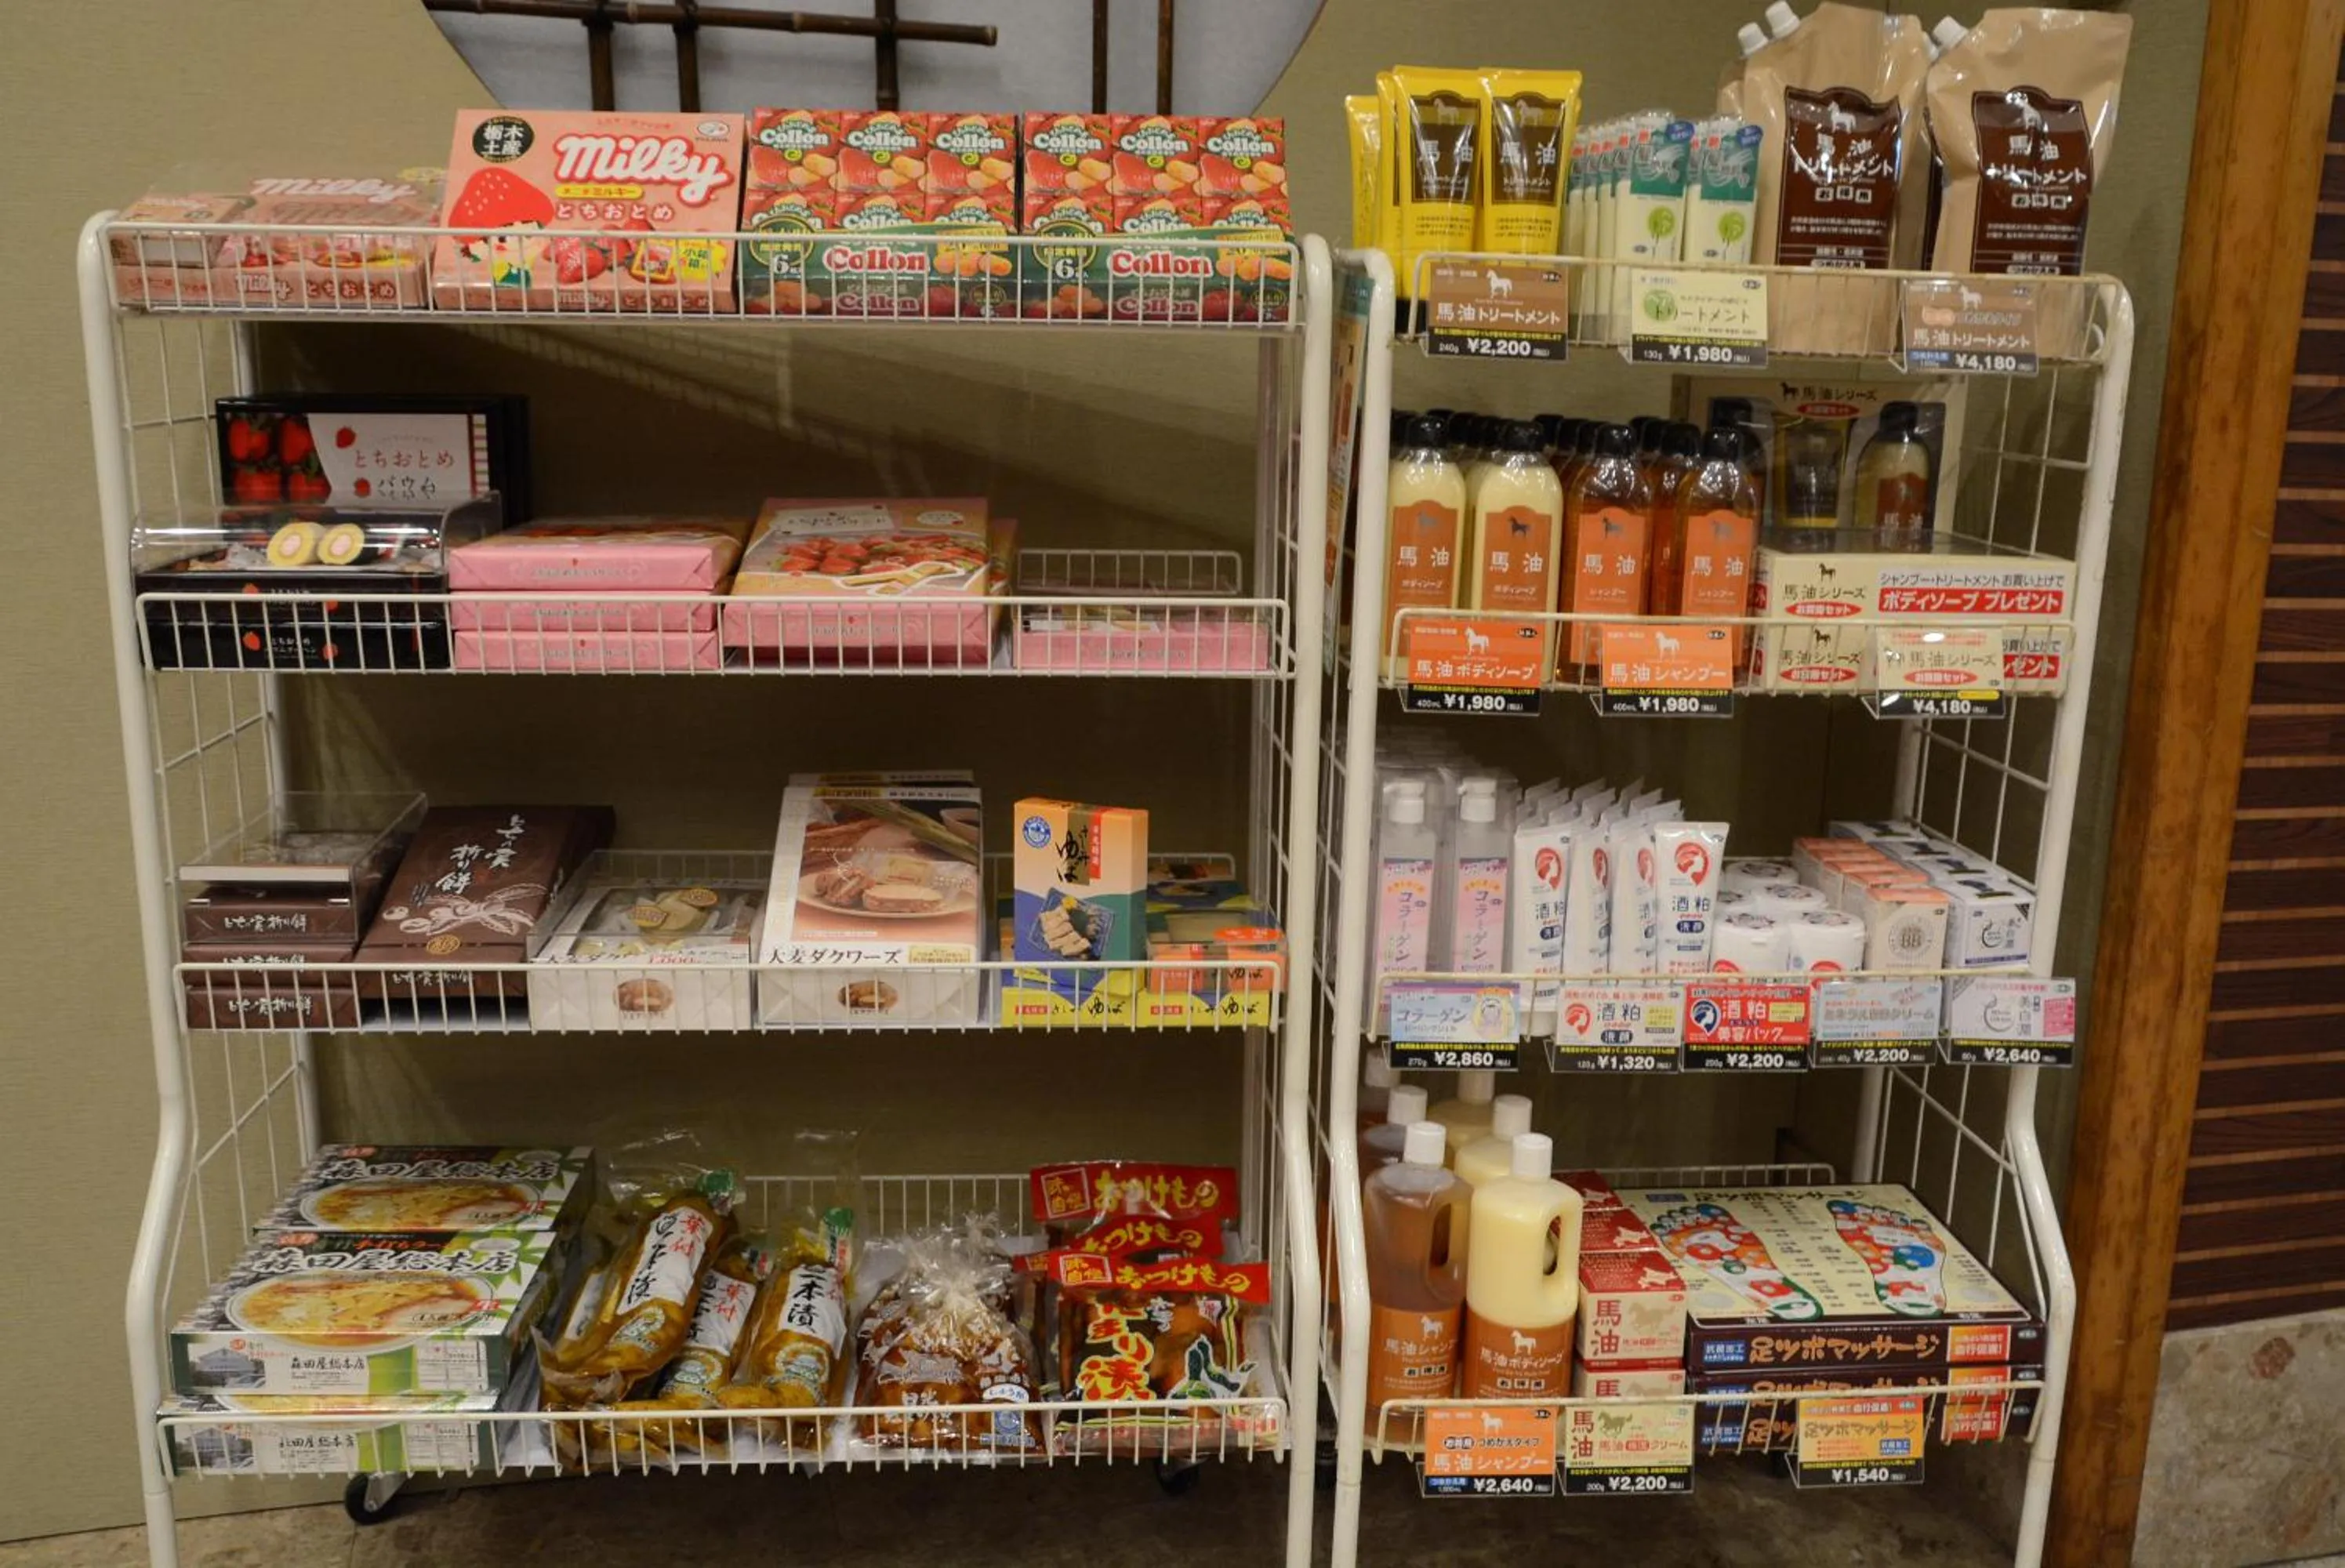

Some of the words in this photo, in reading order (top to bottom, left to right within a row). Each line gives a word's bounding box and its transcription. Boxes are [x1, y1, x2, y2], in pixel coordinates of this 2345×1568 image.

[482, 123, 524, 138] 栃木
[760, 128, 829, 146] Collon
[848, 131, 917, 148] Collon
[936, 132, 1005, 151] Collon
[1034, 132, 1102, 151] Collon
[1120, 135, 1189, 153] Collon
[1206, 136, 1276, 155] Collon
[2009, 135, 2060, 162] 馬油
[1792, 154, 1894, 178] トリートメント
[1985, 162, 2088, 187] トリートメント
[555, 203, 674, 221] とちおとめ
[822, 246, 930, 274] Collon
[1109, 250, 1214, 278] Collon
[1436, 303, 1561, 325] 馬油トリートメント
[1656, 304, 1750, 324] トリートメント
[1468, 338, 1531, 357] ¥2,200
[1913, 328, 2030, 349] 馬油トリートメント
[1668, 344, 1733, 362] ¥1,980
[1955, 354, 2016, 371] ¥4,180
[354, 449, 456, 469] とちおとめ
[1397, 546, 1450, 567] 馬油
[1490, 551, 1544, 573] 馬油
[1582, 554, 1635, 575] 馬油
[1691, 556, 1744, 577] 馬油
[1782, 583, 1867, 601] 馬油シリーズ
[1883, 590, 1980, 610] ボディソープ
[1984, 591, 2060, 610] プレゼント
[1414, 659, 1537, 681] 馬油ボディソープ
[1910, 652, 1997, 668] 馬油シリーズ
[1609, 662, 1727, 685] 馬油シャンプー
[1443, 694, 1506, 710] ¥1,980
[1639, 696, 1700, 713] ¥1,980
[1913, 699, 1971, 716] ¥4,180
[1396, 891, 1414, 963] コラーゲン
[1472, 891, 1489, 961] コラーゲン
[768, 946, 902, 964] 大麦ダクワーズ
[1396, 1007, 1468, 1023] コラーゲン
[1434, 1051, 1494, 1068] ¥2,860
[1597, 1055, 1655, 1071] ¥1,320
[1726, 1053, 1785, 1069] ¥2,200
[1853, 1048, 1910, 1065] ¥2,200
[1984, 1047, 2041, 1064] ¥2,640
[1094, 1170, 1220, 1213] おつけもの
[252, 1248, 519, 1272] 森田屋総本店
[1116, 1262, 1251, 1293] おつけもの
[788, 1264, 828, 1333] 一本漬
[1590, 1300, 1622, 1357] 馬油
[1479, 1346, 1563, 1369] 馬油ボディソープ
[1749, 1334, 1940, 1364] 足ツボマッサージ
[290, 1357, 366, 1370] 森田屋総本店
[1570, 1410, 1595, 1459] 馬油
[1804, 1418, 1918, 1439] 足ツボマッサージ
[1432, 1452, 1549, 1472] 馬油シャンプー
[1473, 1477, 1534, 1494] ¥2,640
[1608, 1475, 1668, 1493] ¥2,200
[1831, 1467, 1889, 1484] ¥1,540
